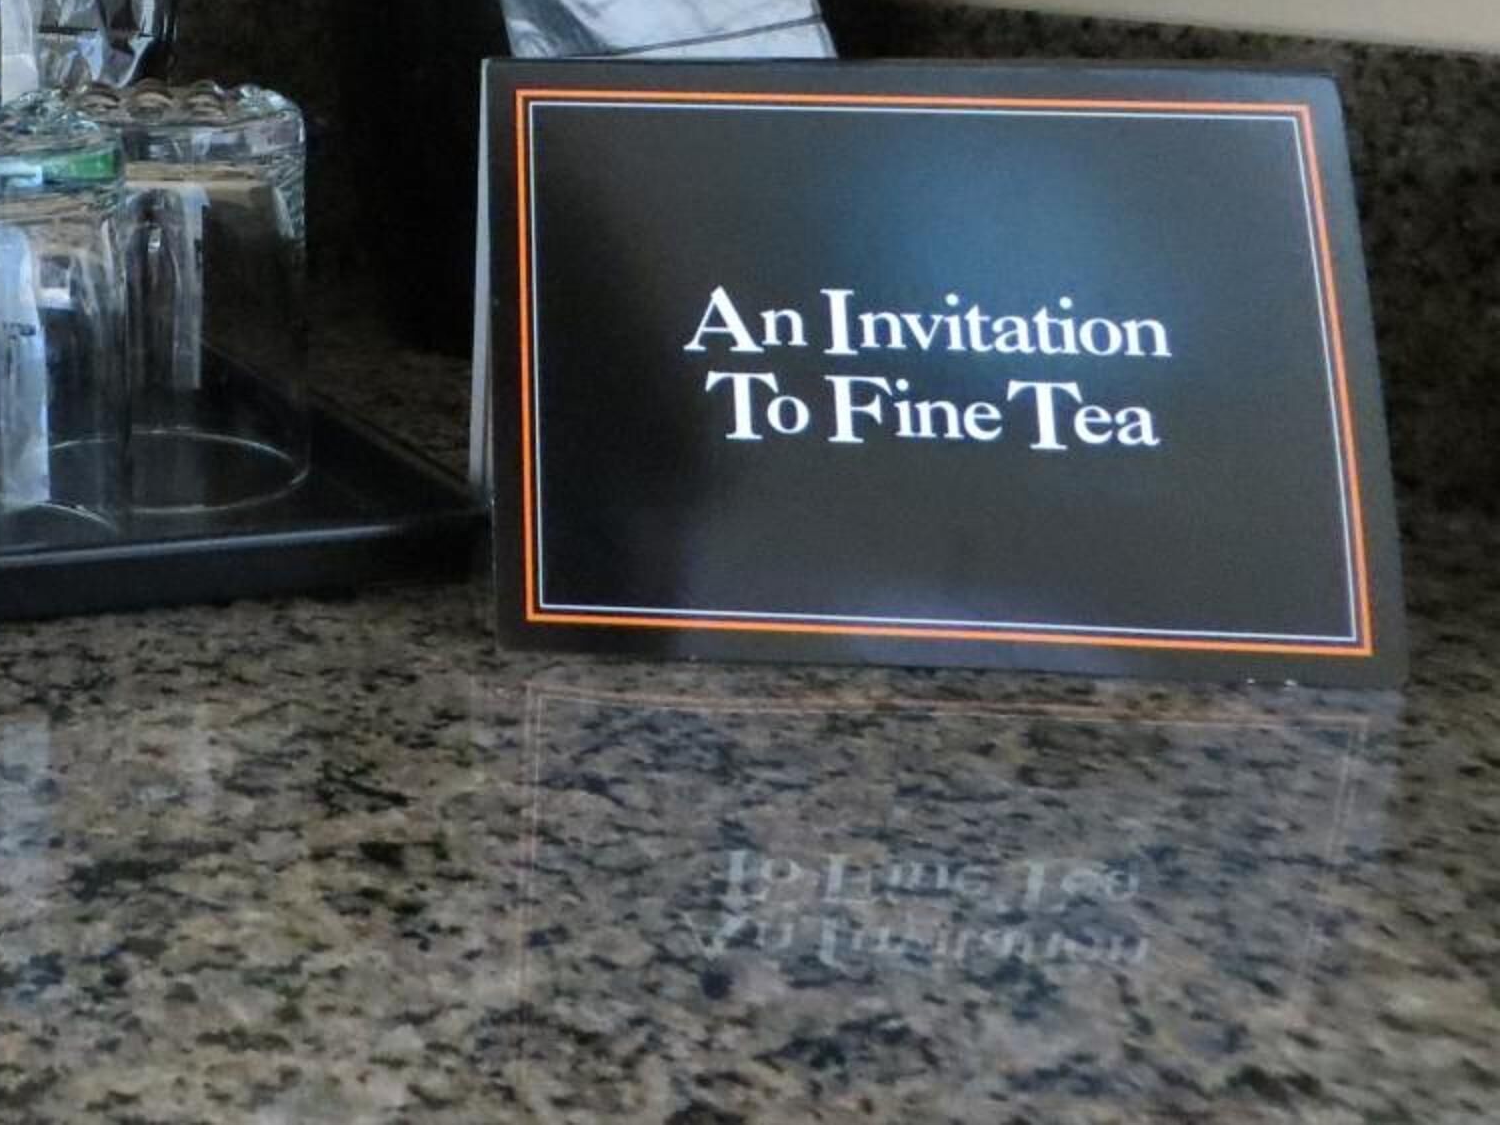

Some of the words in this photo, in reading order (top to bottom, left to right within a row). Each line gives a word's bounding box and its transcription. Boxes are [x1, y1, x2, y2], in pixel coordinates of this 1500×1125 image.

[683, 286, 808, 353] An
[820, 288, 1173, 358] Invitation
[705, 370, 810, 440] To
[824, 375, 1002, 444] Fine
[1006, 379, 1161, 450] Tea
